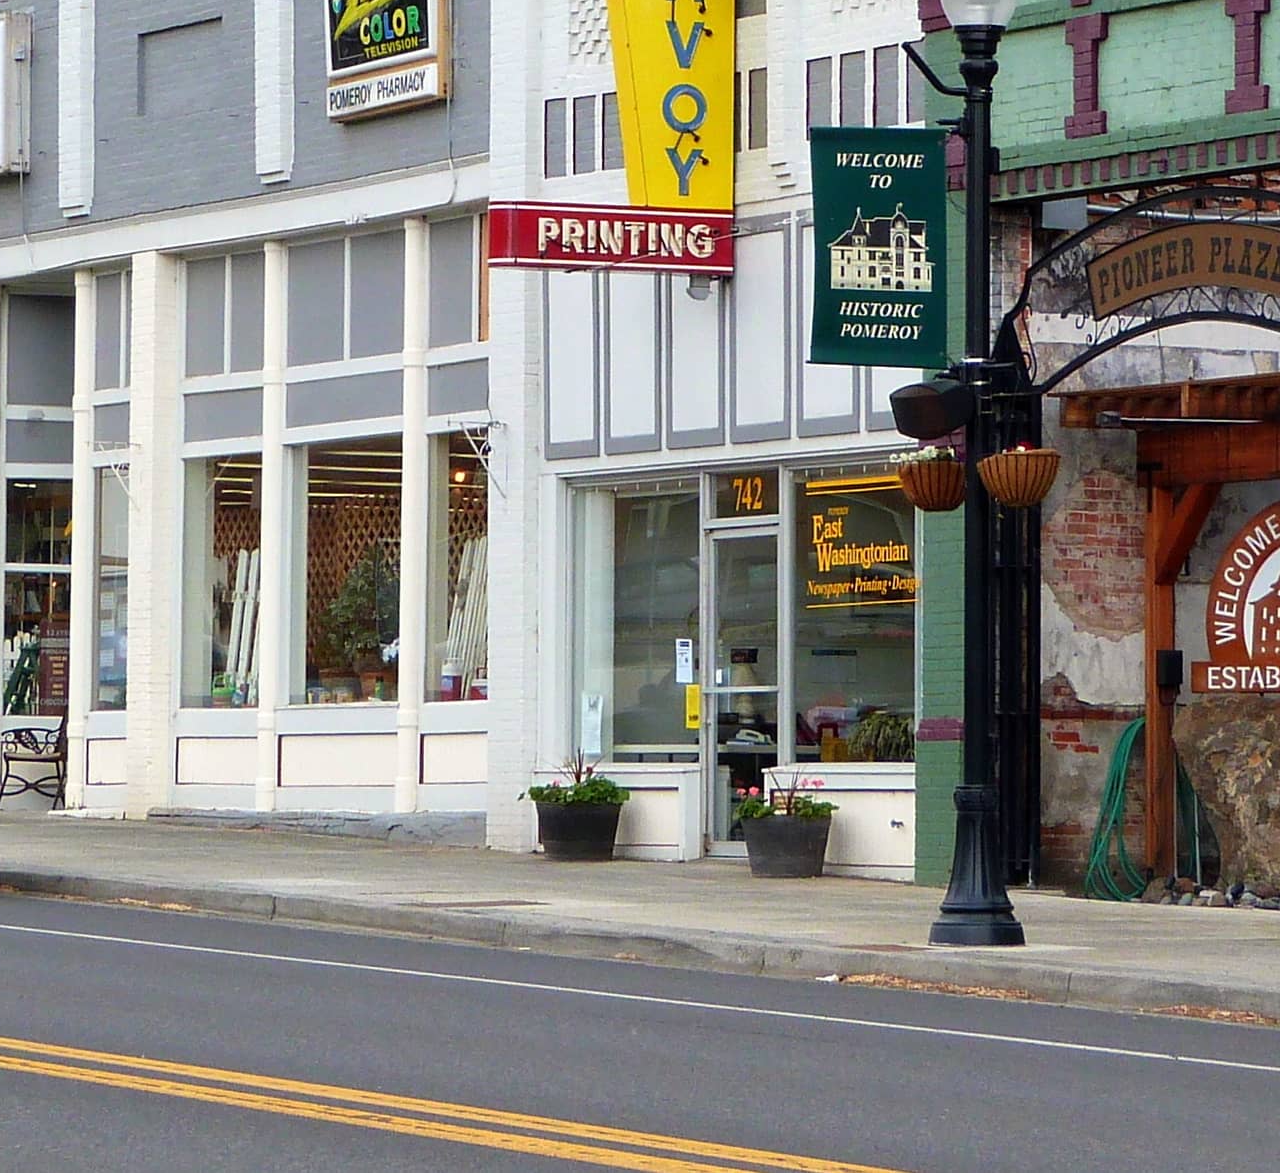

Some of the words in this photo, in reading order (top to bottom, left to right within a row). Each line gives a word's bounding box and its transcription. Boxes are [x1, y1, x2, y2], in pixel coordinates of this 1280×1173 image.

[359, 6, 420, 45] COLOR
[364, 36, 418, 58] TELEVISION
[330, 85, 372, 110] POMEROY
[377, 72, 426, 99] PHARMACY
[836, 153, 924, 168] WELCOME
[869, 174, 892, 189] TO
[537, 217, 716, 258] PRINTING
[1098, 237, 1195, 304] PIONEER
[839, 302, 923, 317] HISTORIC
[840, 323, 922, 339] POMEROY
[733, 477, 763, 511] 742
[812, 515, 843, 544] East
[816, 541, 909, 572] Washingtonian
